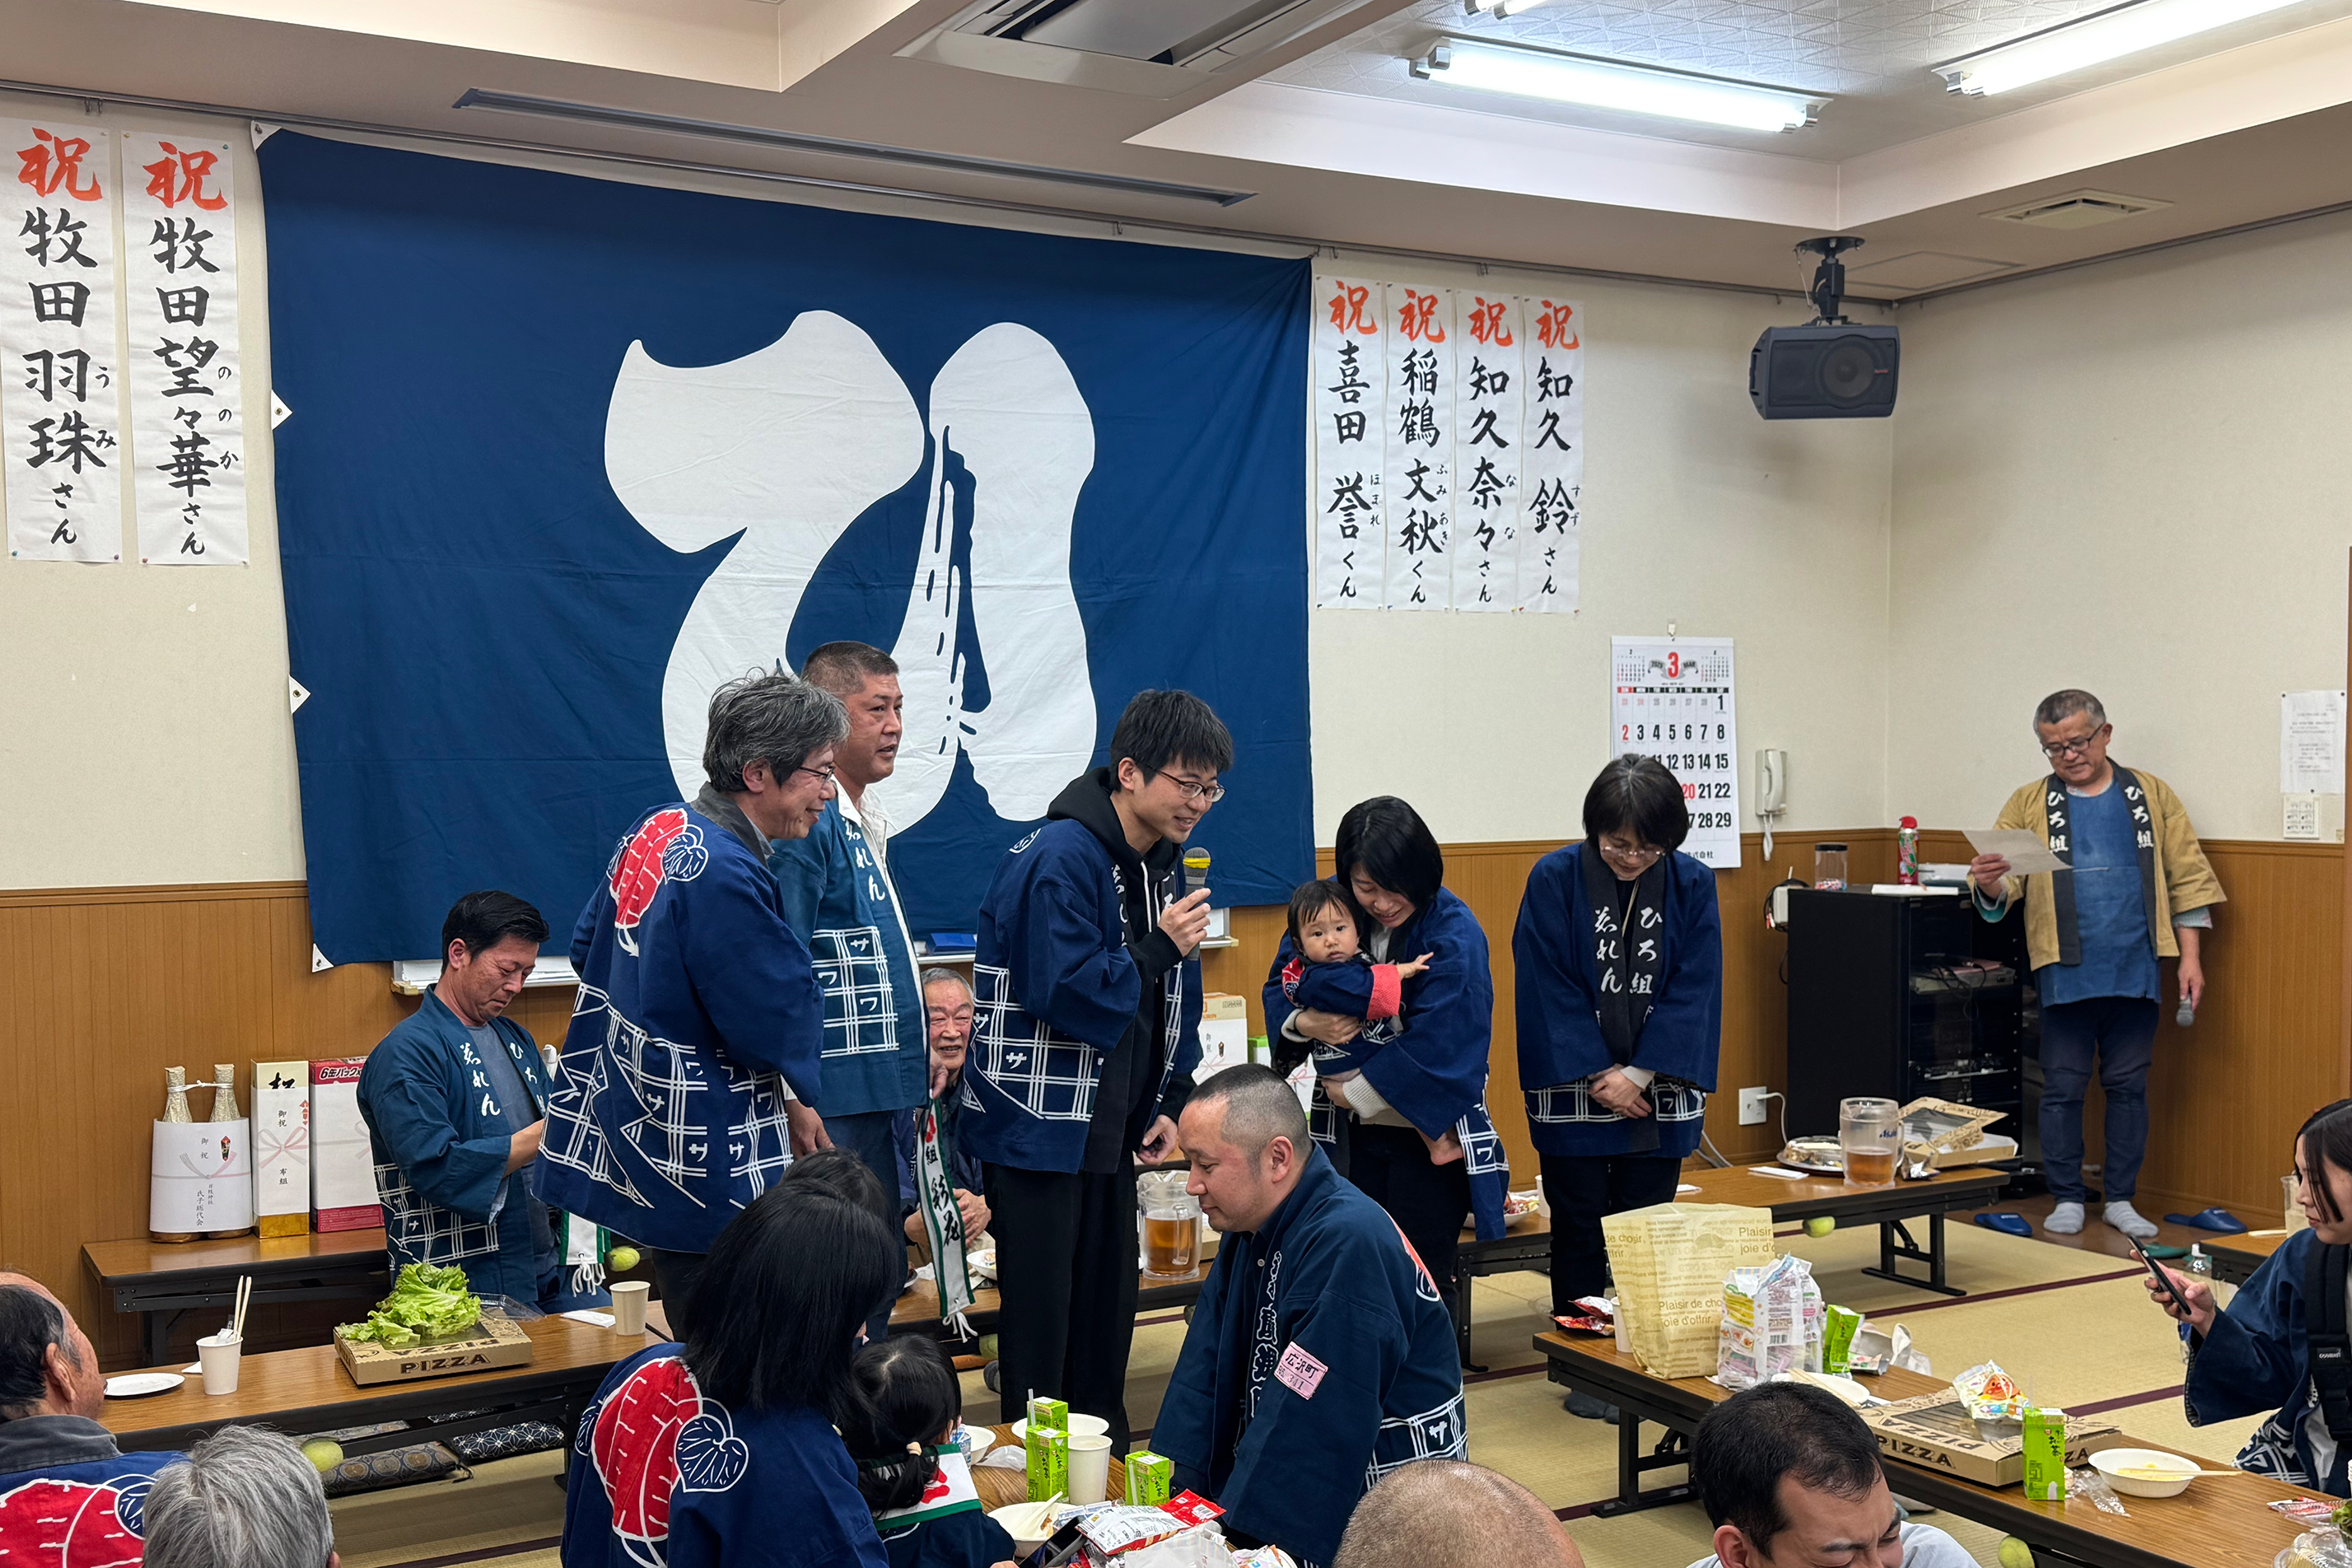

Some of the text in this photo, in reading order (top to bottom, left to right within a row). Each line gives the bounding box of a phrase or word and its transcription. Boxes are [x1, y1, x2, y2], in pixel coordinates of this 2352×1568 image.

[17, 127, 103, 202] 祝
[142, 141, 228, 211] 祝
[1328, 280, 1378, 335] 祝
[1398, 288, 1445, 343] 祝
[1468, 296, 1514, 347] 祝
[1535, 300, 1580, 350] 祝
[1668, 651, 1679, 678] 3
[1717, 694, 1724, 711] 1
[1622, 724, 1725, 740] 2 3 4 5 6 7 8
[1666, 754, 1678, 770] 12
[1682, 754, 1695, 769] 13
[1698, 754, 1711, 769] 14
[1715, 754, 1729, 769] 15
[1682, 782, 1730, 799] 20 21 22
[1698, 813, 1713, 828] 28
[1715, 812, 1732, 828] 29
[1628, 906, 1663, 994] ひろ組
[1739, 1226, 1771, 1237] Plaisir
[1740, 1244, 1759, 1255] joie
[1659, 1300, 1688, 1311] Plaisir
[1690, 1299, 1703, 1309] de
[401, 1353, 491, 1374] PIZZA
[1286, 1353, 1318, 1379] 広沢町
[1875, 1434, 1956, 1469] PIZZA
